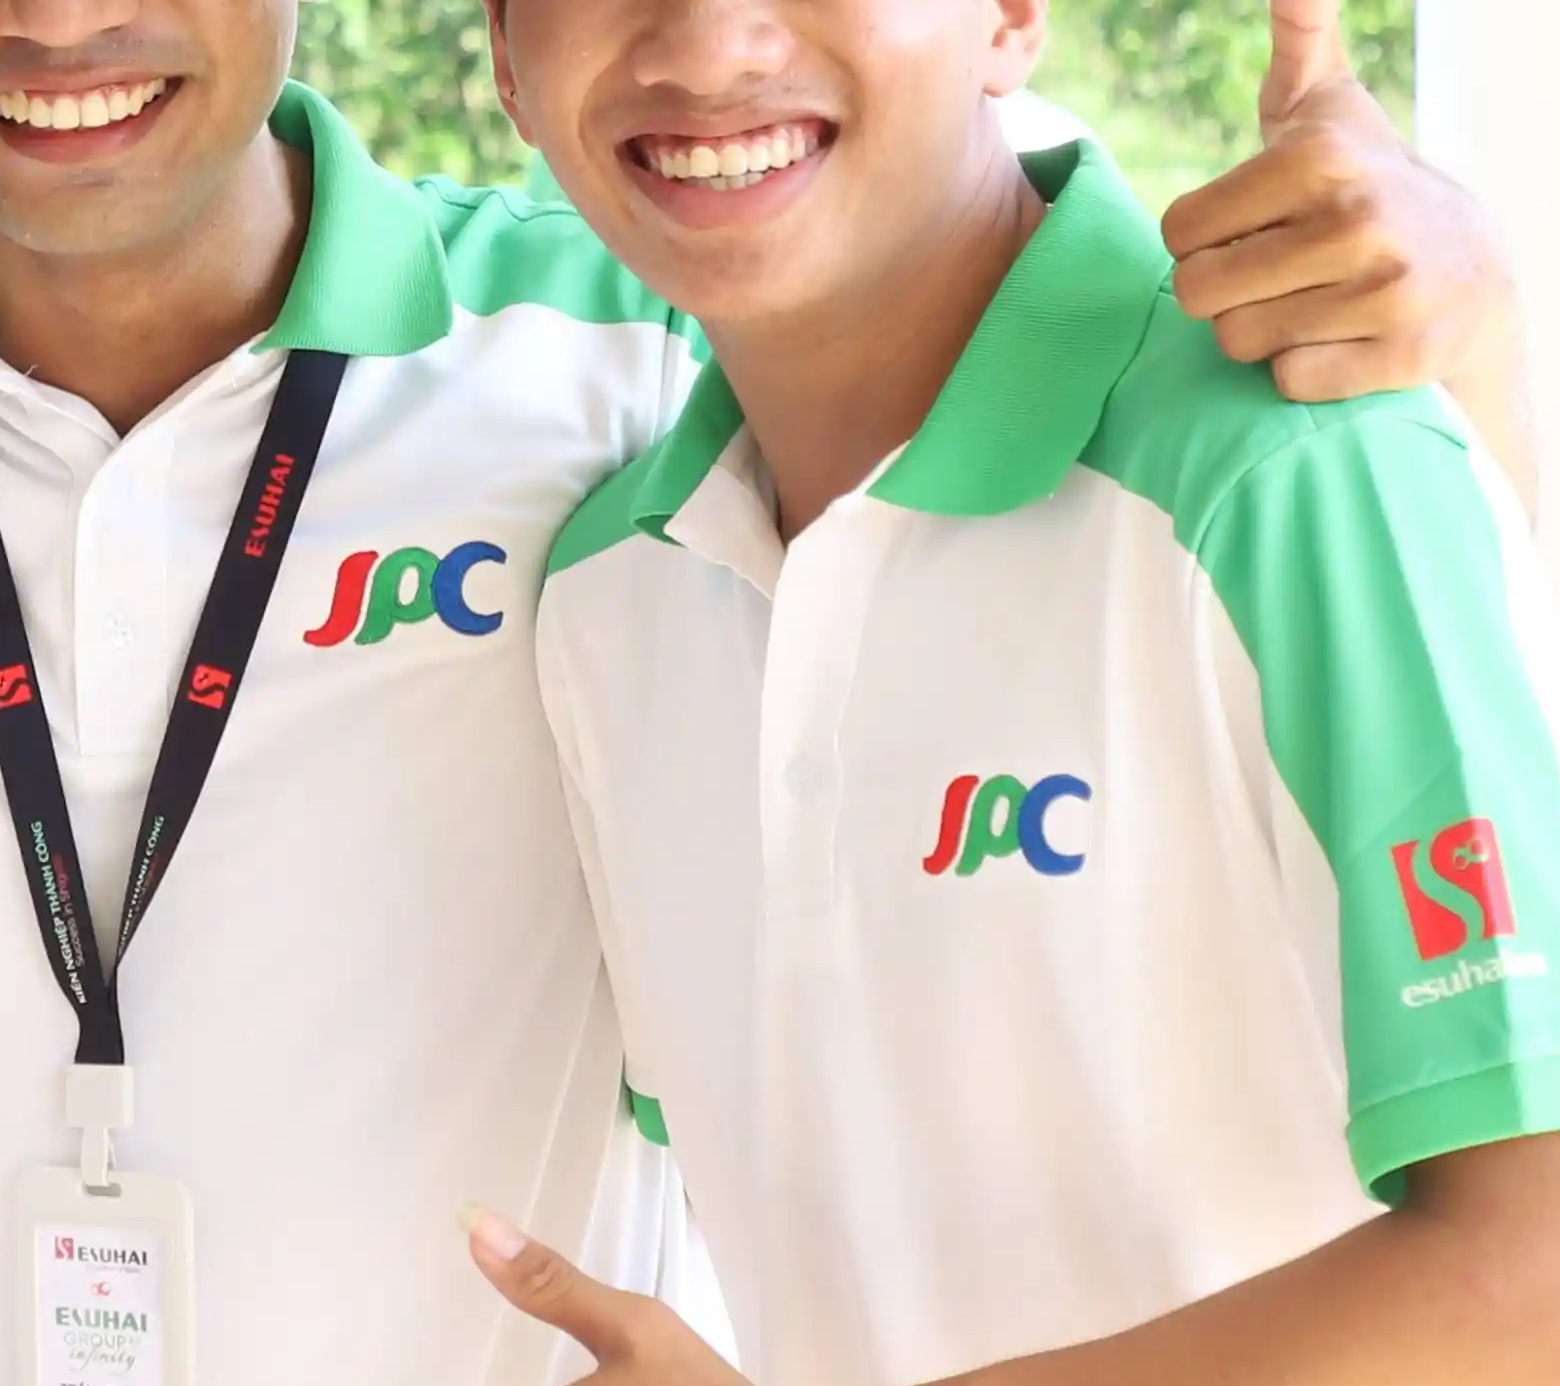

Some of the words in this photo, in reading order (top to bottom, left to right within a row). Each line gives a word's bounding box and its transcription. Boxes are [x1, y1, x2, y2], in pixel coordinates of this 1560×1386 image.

[244, 454, 295, 558] ESUHAI
[303, 541, 507, 647] JPC
[922, 773, 1092, 877] JPC
[77, 1245, 148, 1266] ESUHAI
[55, 1306, 148, 1333] ESUHAI
[63, 1330, 126, 1351] GROUP
